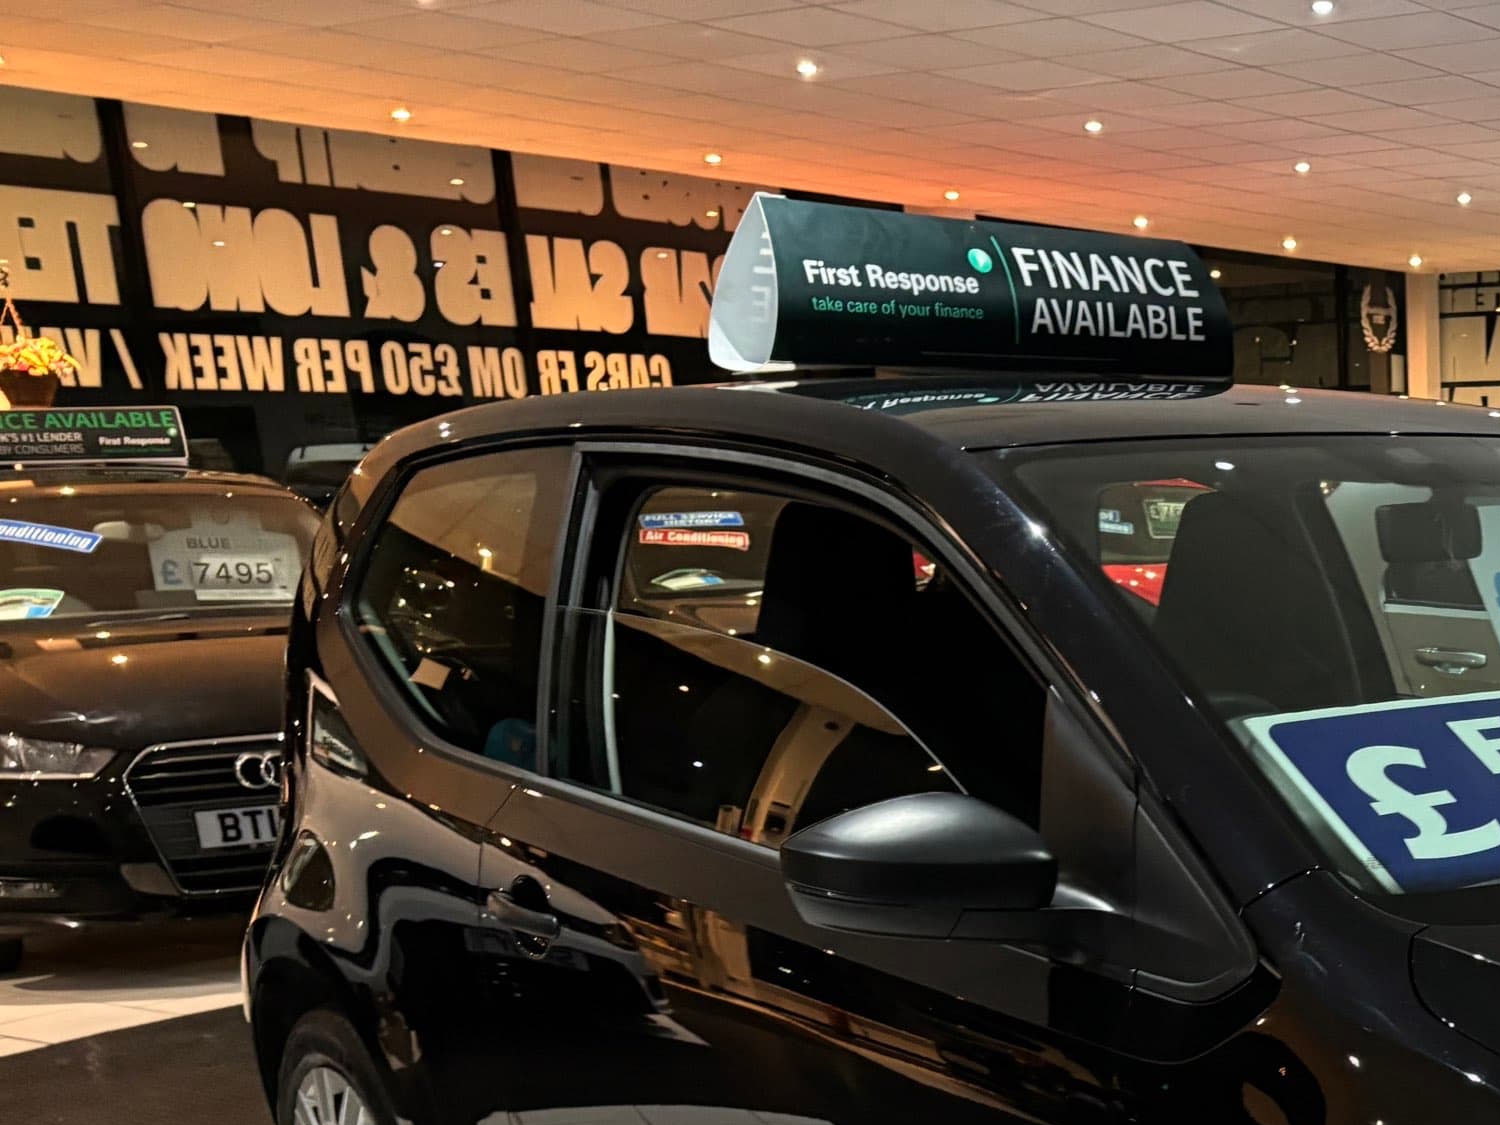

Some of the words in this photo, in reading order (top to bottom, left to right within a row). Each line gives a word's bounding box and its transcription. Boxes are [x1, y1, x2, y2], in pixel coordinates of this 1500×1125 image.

[803, 259, 862, 288] First
[865, 264, 981, 296] Response
[1011, 246, 1200, 298] FINANCE
[812, 296, 843, 313] take
[847, 299, 878, 315] care
[882, 300, 896, 315] of
[899, 304, 930, 319] your
[935, 302, 985, 320] finance
[1031, 297, 1206, 341] AVAILABLE
[0, 412, 38, 430] CE
[44, 410, 176, 430] AVAILABLE
[36, 431, 83, 443] LENDER
[98, 436, 122, 446] First
[123, 436, 171, 448] Response
[186, 536, 232, 550] BLUE
[645, 530, 664, 542] Air
[667, 530, 744, 549] Conditioning
[161, 559, 183, 586] £
[193, 561, 273, 585] 7495
